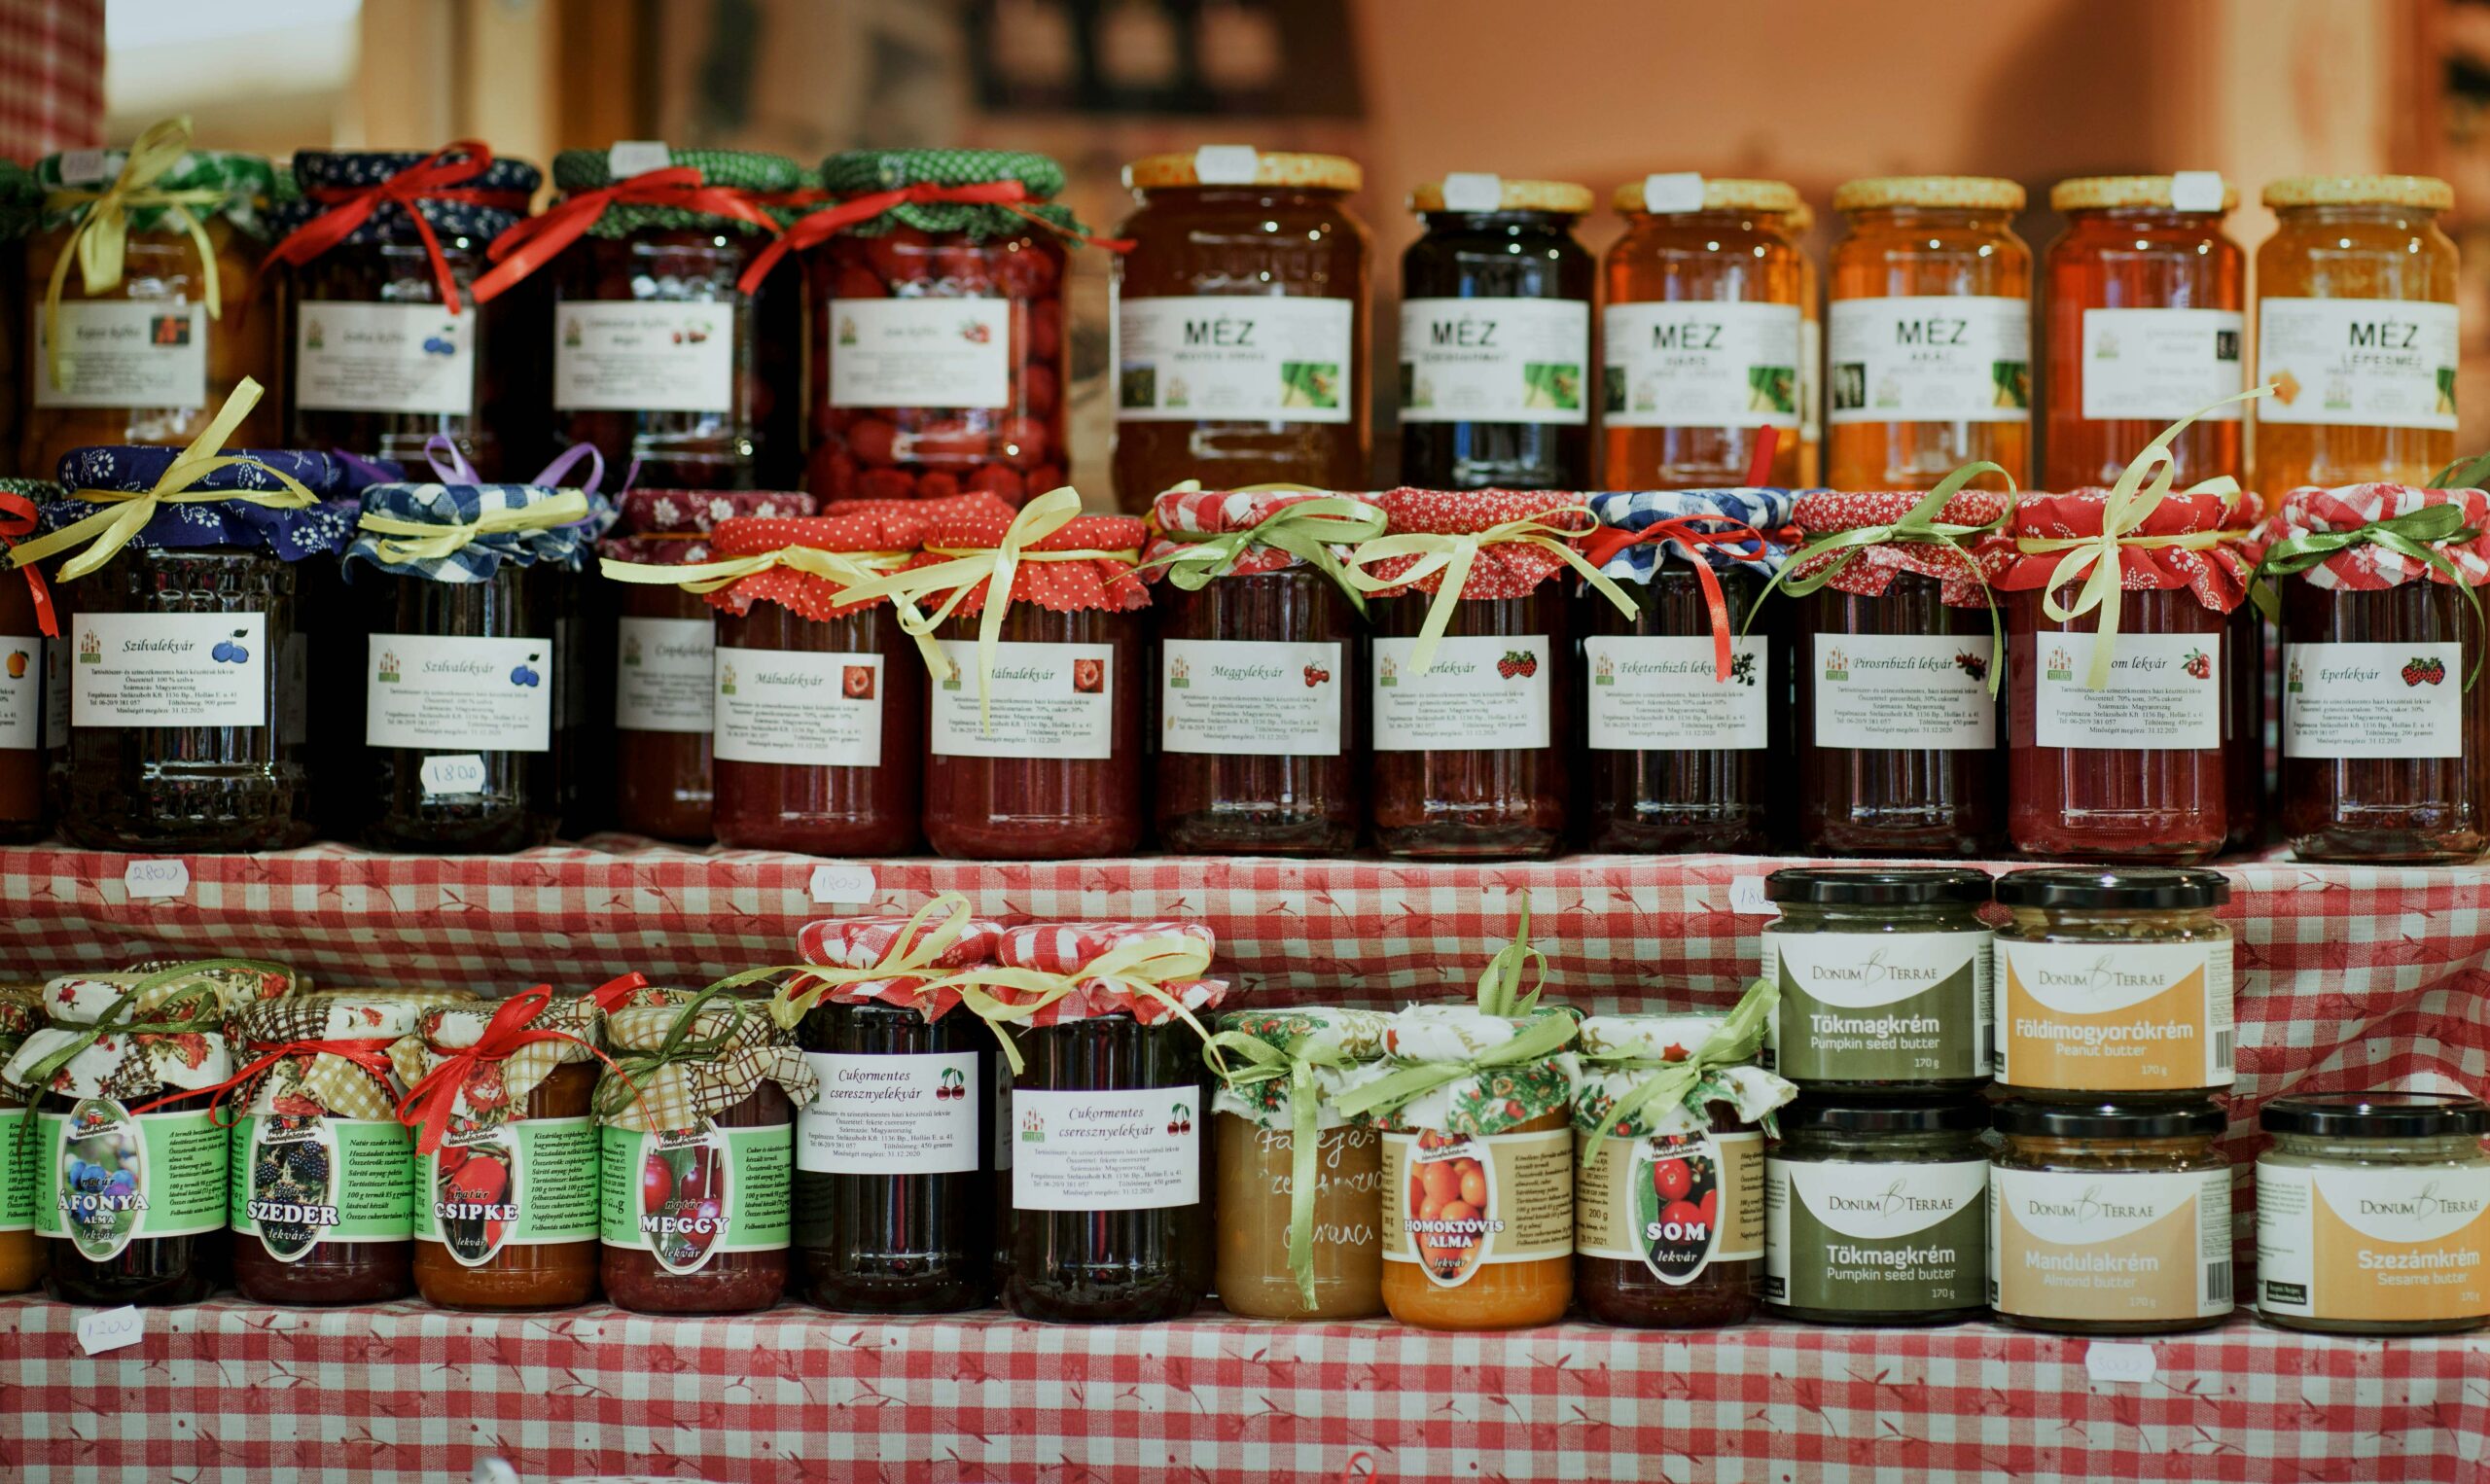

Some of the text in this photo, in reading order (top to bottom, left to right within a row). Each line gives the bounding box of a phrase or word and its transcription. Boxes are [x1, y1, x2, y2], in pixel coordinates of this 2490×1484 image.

[1185, 312, 1255, 346] MÉZ
[1432, 312, 1497, 347] MÉZ
[1654, 315, 1723, 350] MÉZ
[1897, 312, 1968, 346] MÉZ
[2350, 315, 2419, 349] MÉZ
[123, 639, 196, 654] Szilvalekvár
[422, 660, 495, 675] Szilvalekvár
[1619, 660, 1717, 676] Feketeribizli lekv
[1852, 655, 1953, 673] Pirosribizli lekvár
[2111, 655, 2168, 672] om lekvár
[755, 672, 825, 689] Málnalekvár
[991, 667, 1055, 682] álnalekvár
[1211, 664, 1284, 681] Meggylekvár
[2320, 667, 2380, 684] Eperlekvár
[434, 764, 477, 782] 1800
[1741, 887, 1775, 906] 180
[1813, 966, 1938, 980] DONUM TERRAE
[2039, 971, 2165, 987] DONUM TERRAE
[1809, 1013, 1939, 1039] Tökmagkrém
[2015, 1018, 2193, 1045] Földimogyorókrém
[1811, 1037, 1940, 1052] Pumpkin seed butter
[2055, 1042, 2147, 1057] Peanut butter
[1914, 1058, 1939, 1070] 170 g
[2142, 1065, 2158, 1075] 170
[838, 1068, 910, 1083] Cukormentes
[830, 1087, 923, 1103] cseresznyelekvár
[1069, 1106, 1144, 1121] Cukormentes
[1058, 1124, 1155, 1141] cseresznyelekvár
[56, 1189, 150, 1212] ÁFONYA
[1829, 1196, 1953, 1211] DONUM TERRAE
[2361, 1200, 2414, 1215] DONUM
[246, 1199, 340, 1226] SZEDER
[433, 1202, 518, 1221] CSIPKE
[1588, 1209, 1608, 1221] 200 g
[2029, 1200, 2154, 1218] DONUM TERRAE
[84, 1216, 116, 1224] ALMA
[640, 1215, 729, 1234] MEGGY
[1404, 1218, 1505, 1233] HOMOKTÖVIS
[82, 1228, 116, 1241] lekvár
[268, 1227, 303, 1240] lekvár
[1647, 1221, 1706, 1241] SOM
[457, 1237, 485, 1246] lekvár
[1428, 1235, 1474, 1249] ALMA
[664, 1247, 700, 1258] lekvár
[1657, 1251, 1697, 1262] lekvár
[1827, 1245, 1955, 1270] Tökmagkrém
[2357, 1248, 2480, 1269] Szezámkrém
[1434, 1257, 1467, 1268] lekvár
[2025, 1250, 2159, 1272] Mandulakrém
[1827, 1266, 1956, 1284] Pumpkin seed butter
[2044, 1274, 2137, 1289] Almond butter
[2377, 1271, 2469, 1287] Sesame butter
[1932, 1289, 1955, 1299] 170 g
[88, 1320, 133, 1338] 1200
